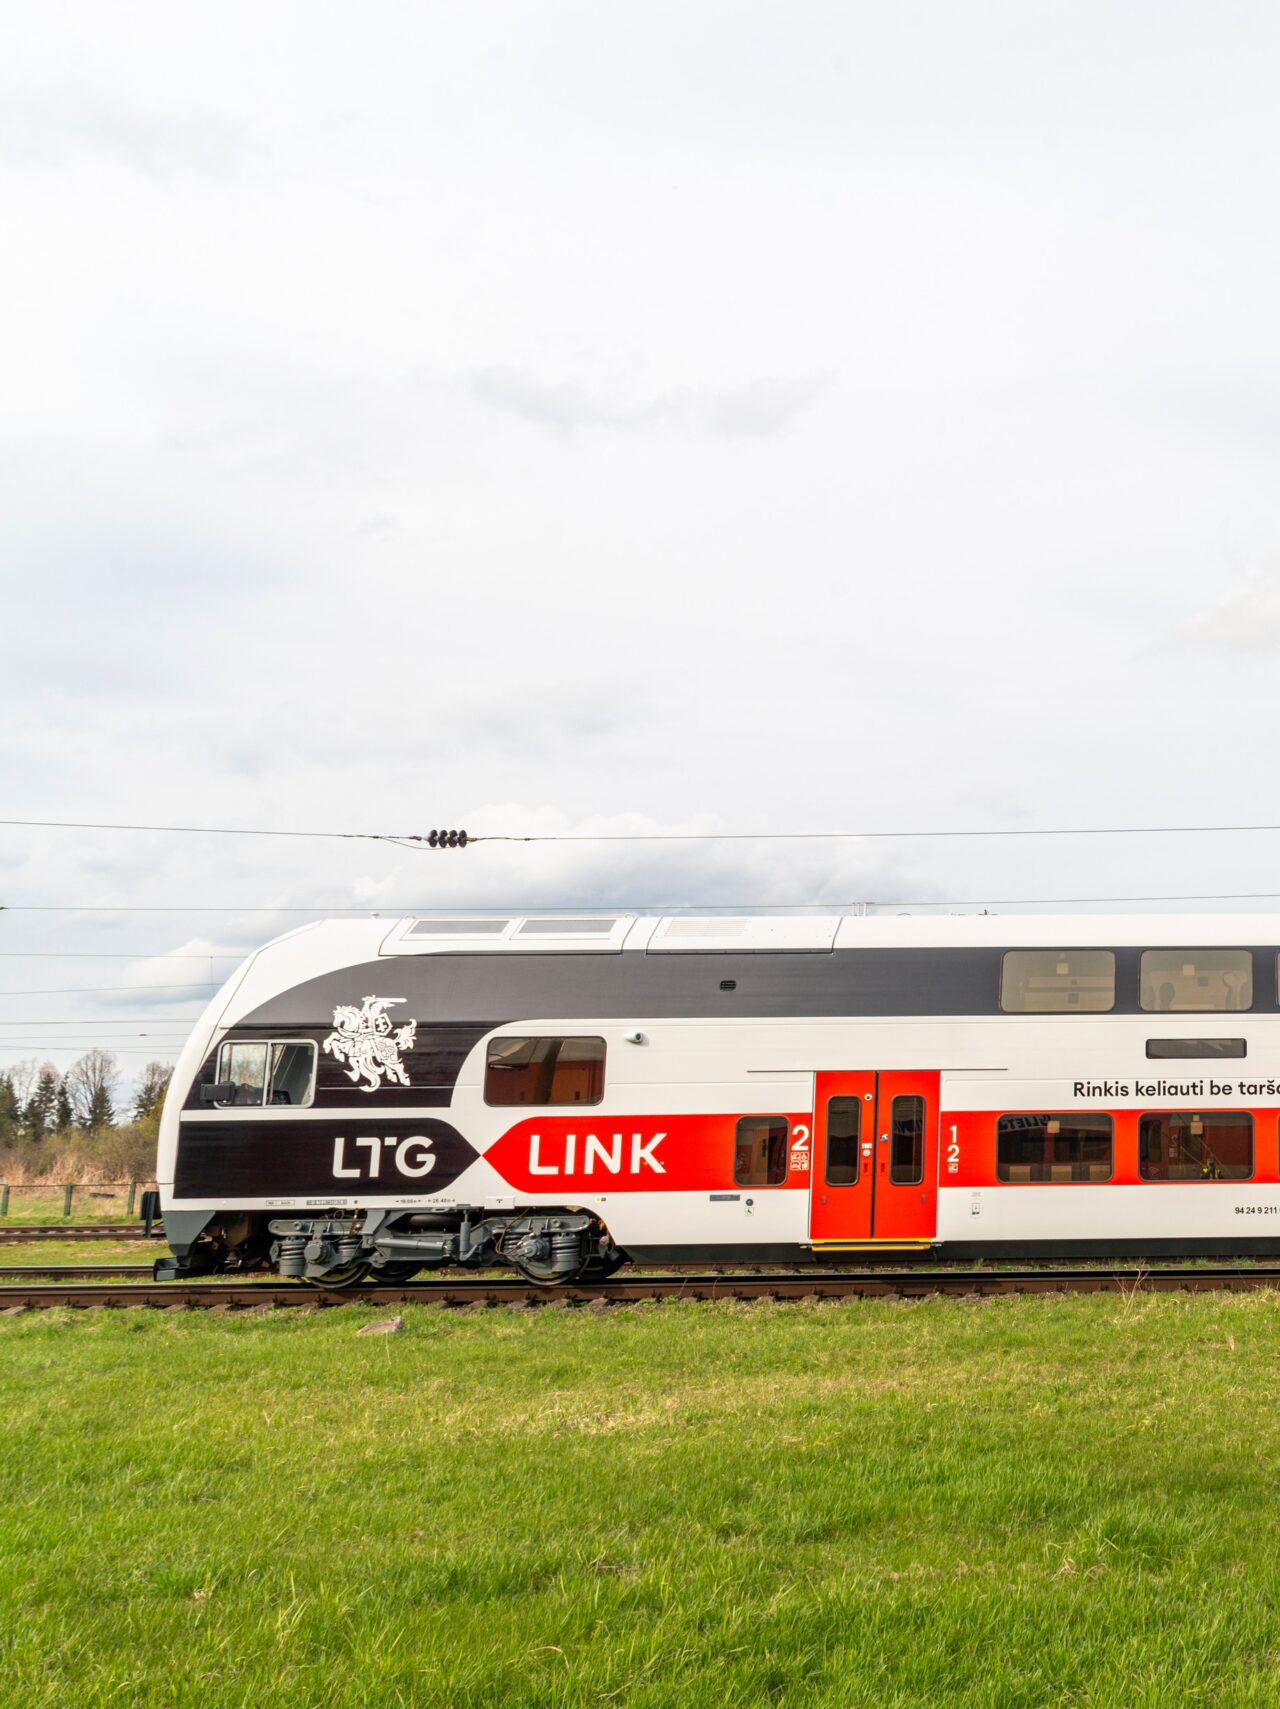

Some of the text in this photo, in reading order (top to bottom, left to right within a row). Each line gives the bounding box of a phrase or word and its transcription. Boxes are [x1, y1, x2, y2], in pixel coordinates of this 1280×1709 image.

[1073, 1080, 1129, 1097] Rinkis
[1135, 1079, 1204, 1097] keliauti
[1210, 1079, 1233, 1096] be
[791, 1125, 809, 1151] 2
[950, 1125, 958, 1143] 1
[332, 1136, 437, 1178] LTG
[528, 1133, 668, 1176] LINK
[947, 1144, 960, 1163] 2
[1234, 1206, 1245, 1215] 94
[1245, 1206, 1256, 1215] 24
[1257, 1206, 1263, 1215] 9
[1263, 1206, 1278, 1215] 211
